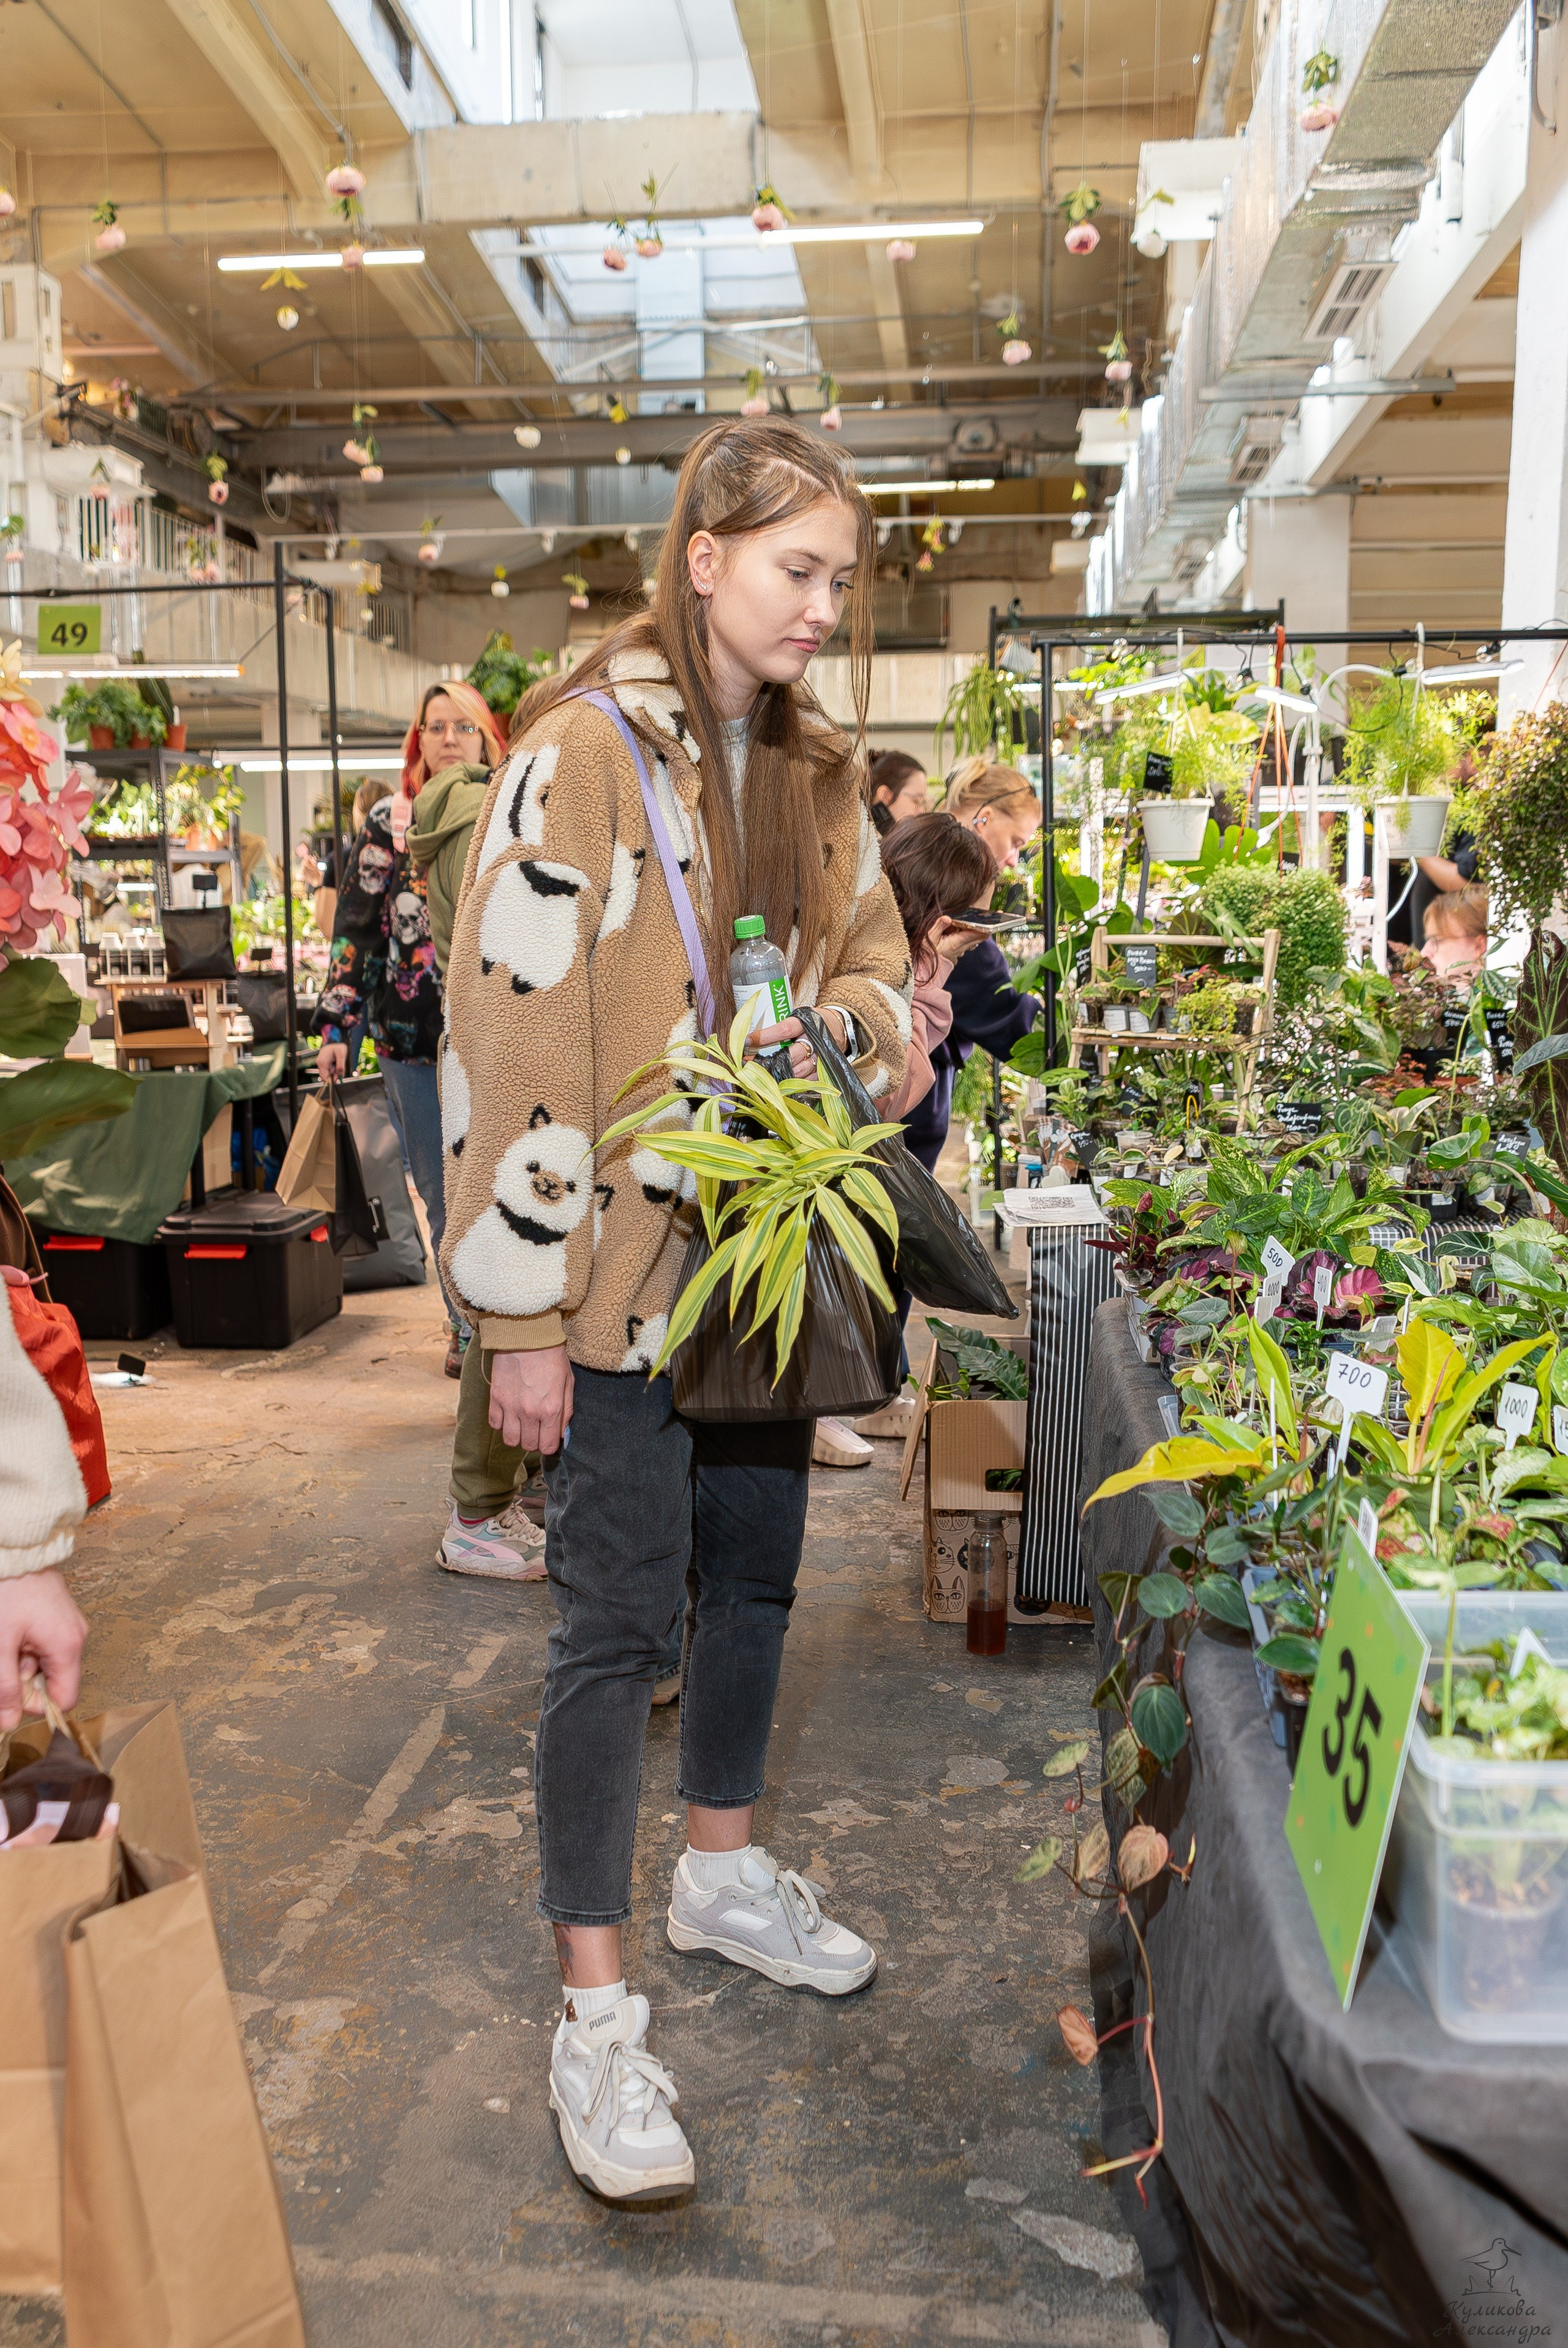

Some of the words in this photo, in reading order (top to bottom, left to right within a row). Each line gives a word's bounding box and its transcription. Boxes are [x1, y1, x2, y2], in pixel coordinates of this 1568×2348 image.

[51, 622, 88, 647] 49
[773, 984, 789, 1023] RINK
[1267, 1247, 1283, 1267] 500
[1317, 1273, 1327, 1294] 400
[1338, 1363, 1372, 1388] 700
[1504, 1396, 1528, 1419] 1000
[1322, 1646, 1382, 1828] 35
[589, 2010, 617, 2032] PUMA
